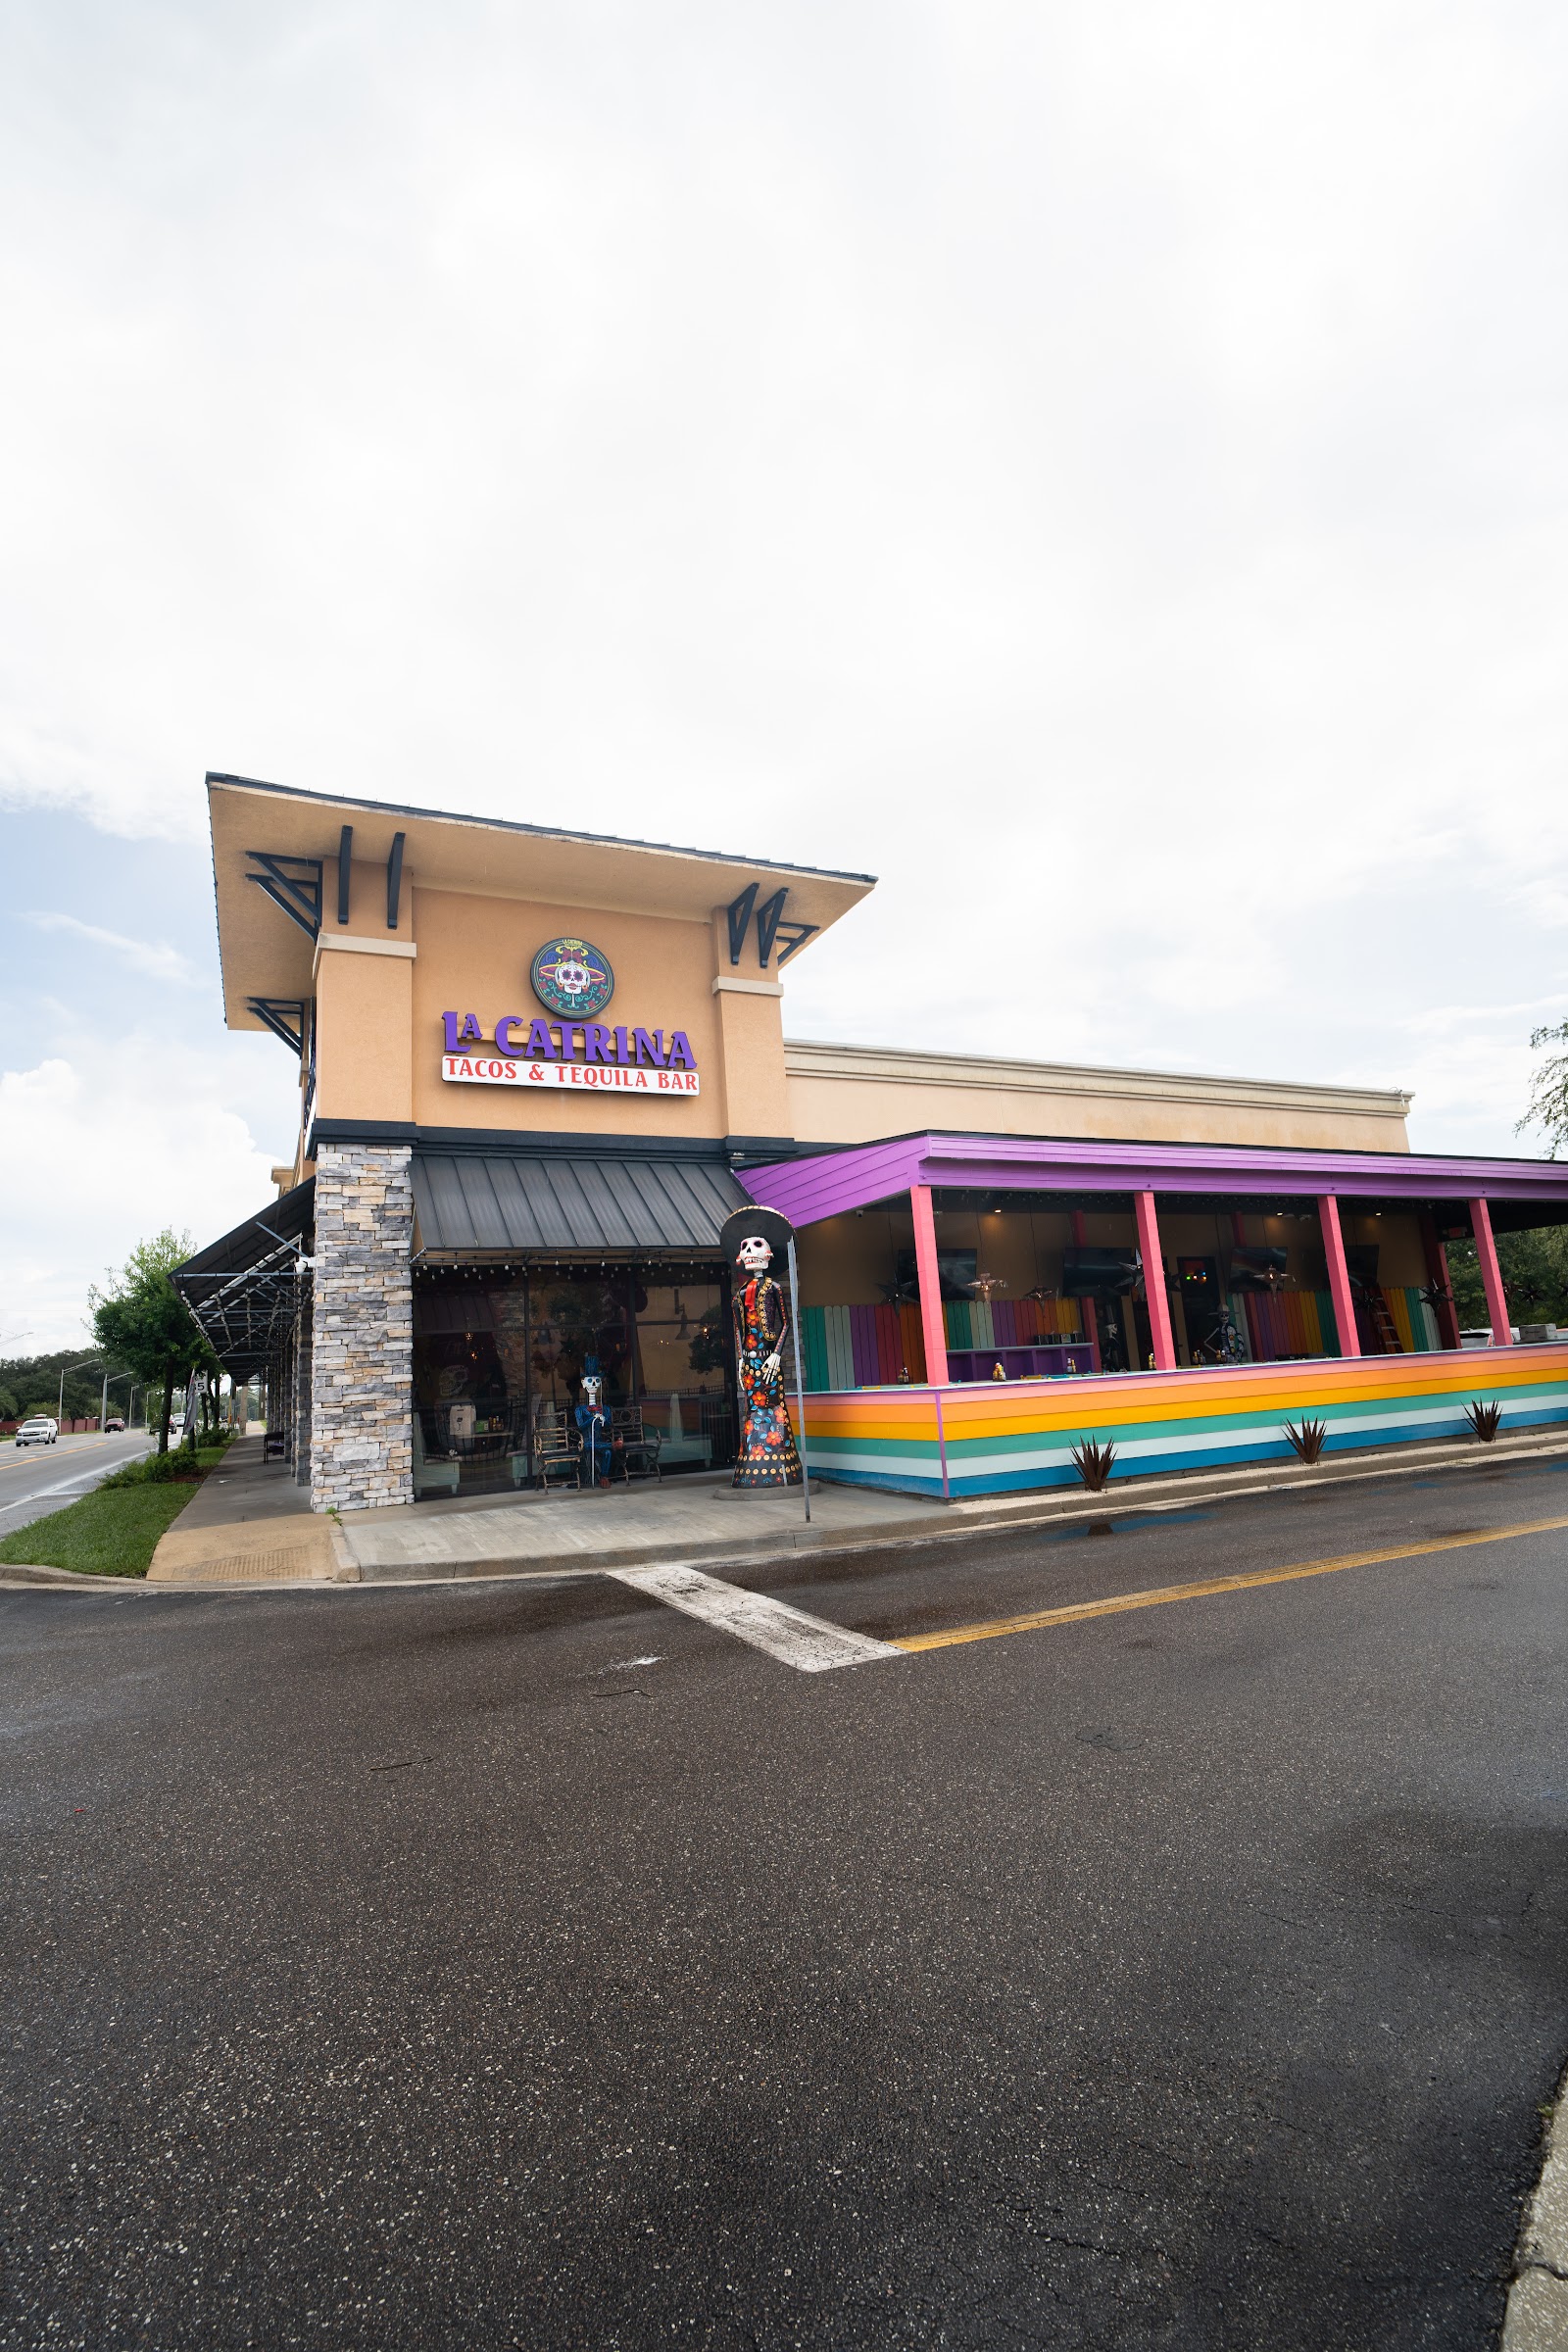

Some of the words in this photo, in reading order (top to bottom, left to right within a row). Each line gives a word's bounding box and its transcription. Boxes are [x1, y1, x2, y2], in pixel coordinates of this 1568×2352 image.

[442, 1010, 483, 1054] LA
[495, 1015, 698, 1069] CATRINA
[445, 1057, 517, 1080] TACOS
[528, 1063, 545, 1081] &
[555, 1065, 648, 1088] TEQUILA
[658, 1072, 698, 1091] BAR
